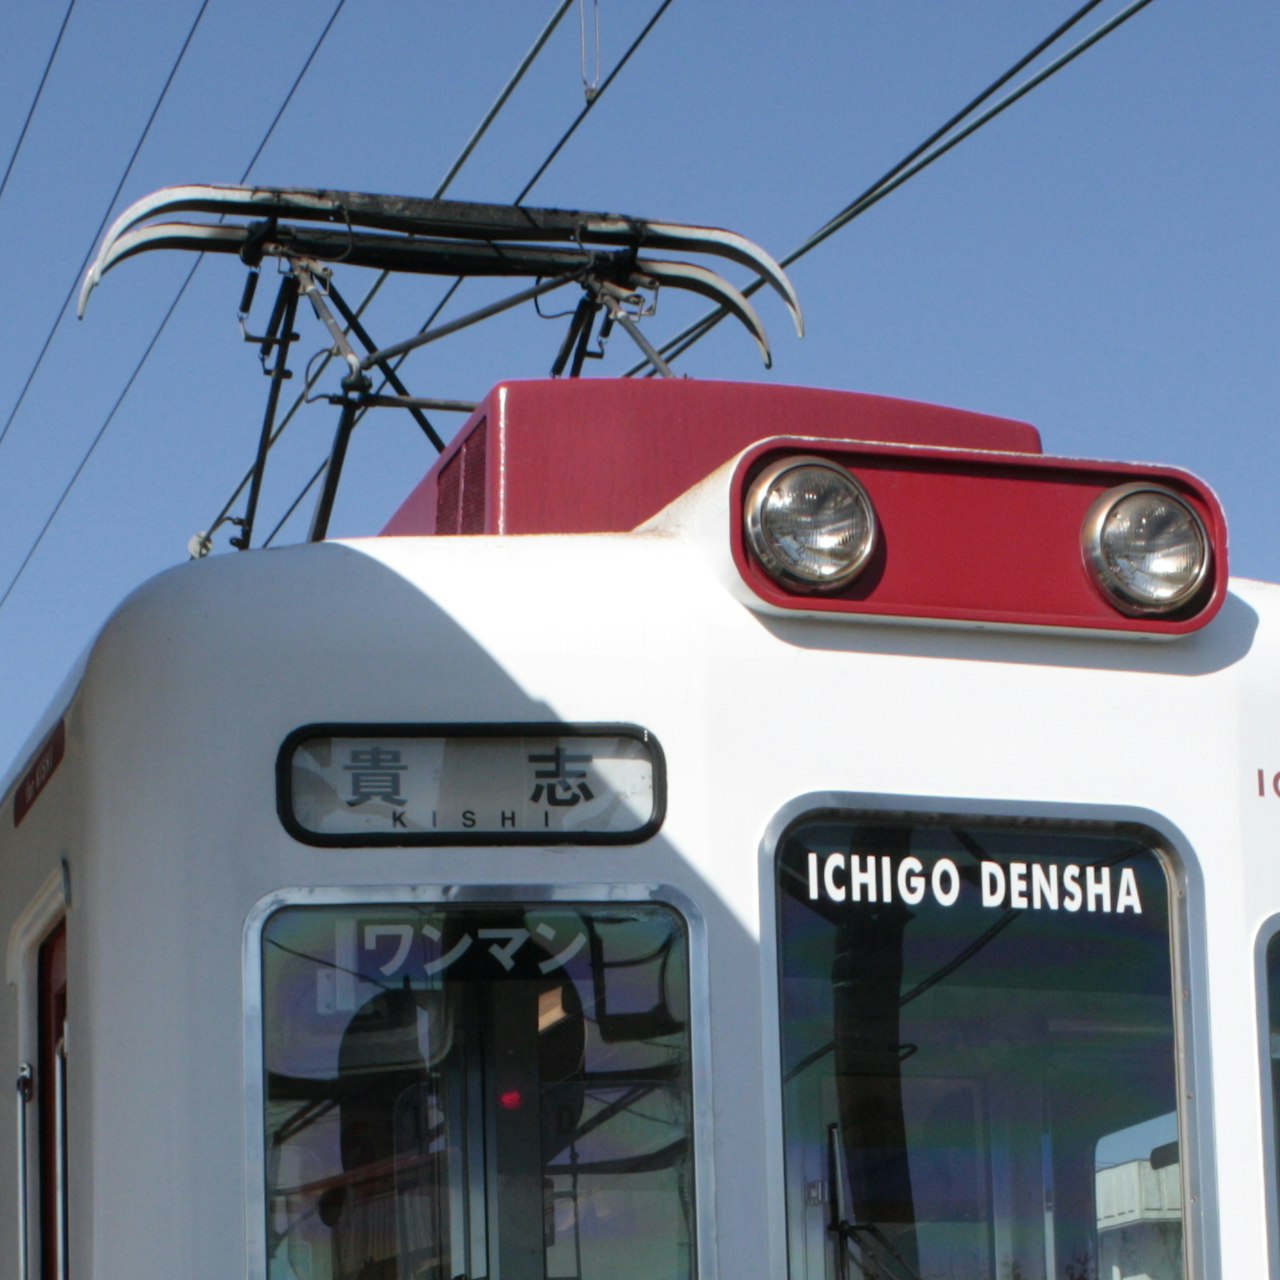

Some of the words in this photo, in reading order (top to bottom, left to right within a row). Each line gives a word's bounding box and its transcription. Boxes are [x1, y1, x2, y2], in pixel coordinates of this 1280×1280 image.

[391, 810, 550, 829] KISHI
[807, 852, 961, 907] ICHIGO
[980, 860, 1143, 914] DENSHA
[363, 922, 587, 978] ワンマン
